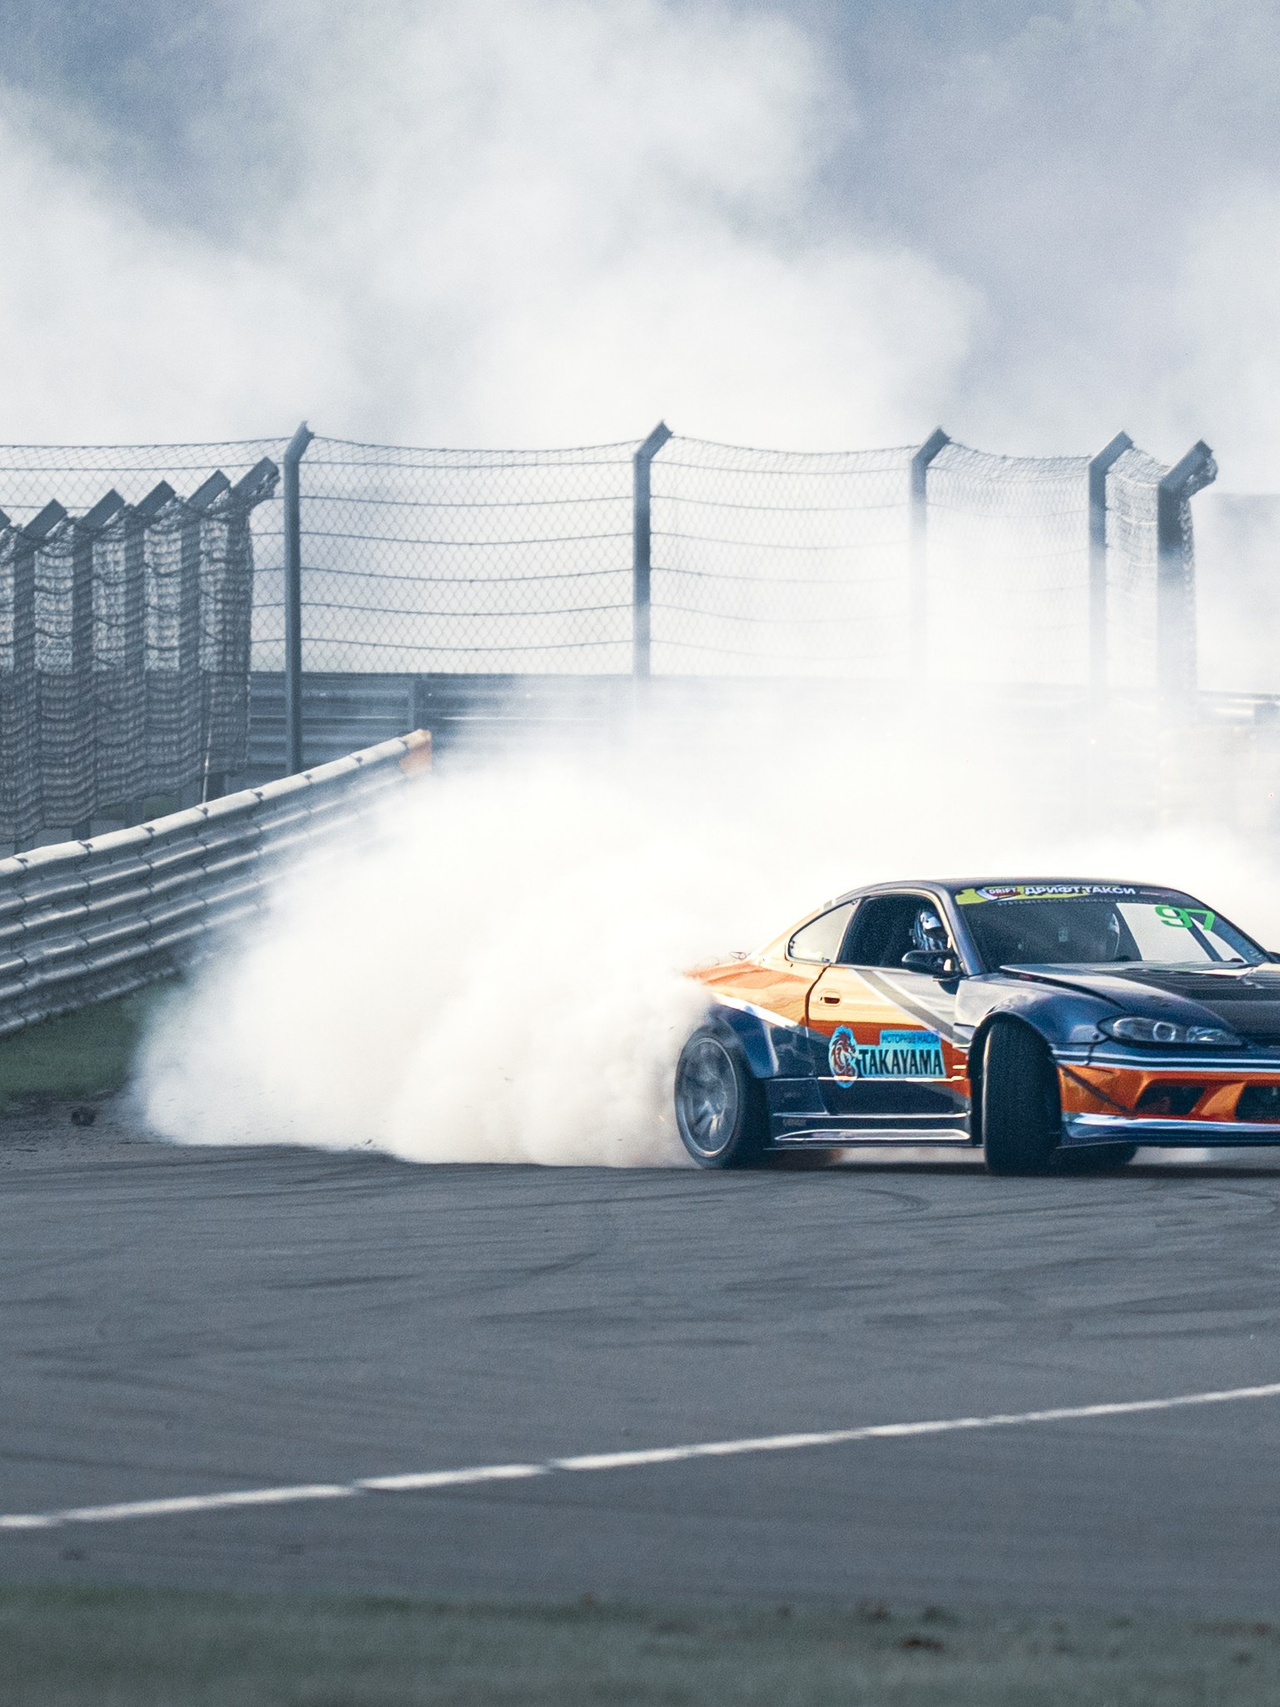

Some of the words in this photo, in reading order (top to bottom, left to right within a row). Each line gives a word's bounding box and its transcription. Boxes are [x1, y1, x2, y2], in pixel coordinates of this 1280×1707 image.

[988, 886, 1018, 895] DRIFT
[1024, 884, 1080, 895] ДРИФТ
[1082, 886, 1136, 895] ТАКСИ
[1155, 905, 1216, 931] 97
[858, 1049, 944, 1076] TAKAYAMA
